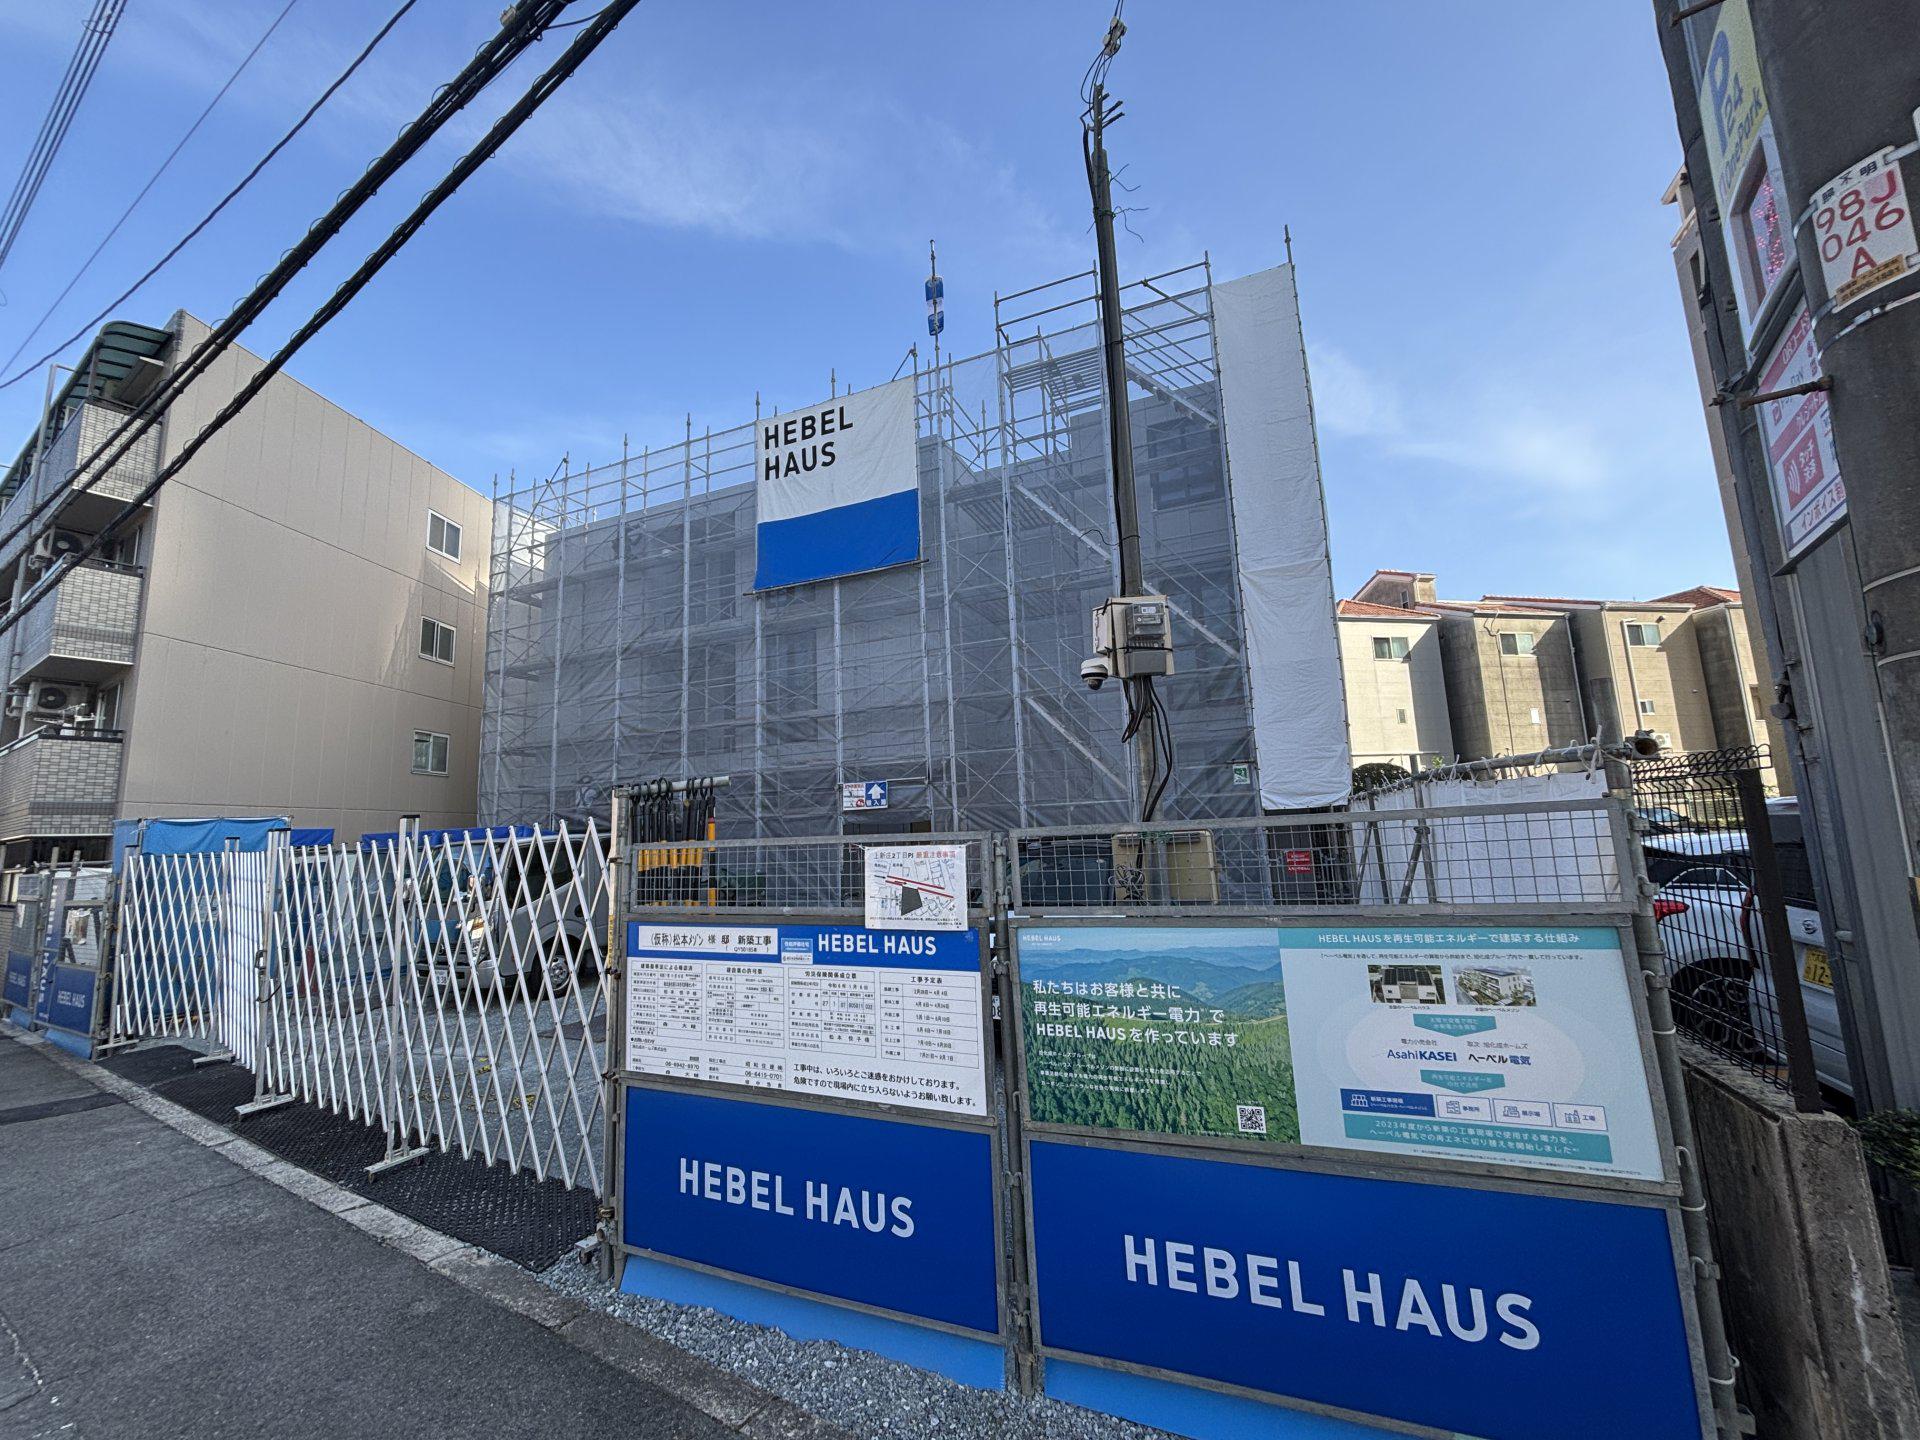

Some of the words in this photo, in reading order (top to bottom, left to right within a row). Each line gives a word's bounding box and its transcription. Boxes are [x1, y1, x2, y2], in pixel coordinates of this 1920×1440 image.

[1724, 72, 1744, 138] 24
[1816, 169, 1897, 234] 98J
[1821, 201, 1906, 263] 046
[1851, 246, 1877, 279] A
[764, 405, 854, 451] HEBEL
[764, 441, 837, 482] HAUS
[737, 934, 772, 947] 新築工事
[818, 933, 879, 954] HEBEL
[884, 935, 937, 956] HAUS
[1318, 934, 1351, 943] HEBEL
[1353, 934, 1382, 943] HAUS
[1383, 933, 1580, 944] を再生可能エネルギーで建築する仕組み
[910, 976, 943, 984] 工事予定表
[1032, 979, 1181, 1000] 私たちはお客様と共に
[1033, 1000, 1200, 1024] 再生可能エネルギー電力
[1036, 1023, 1082, 1039] HEBEL
[1086, 1026, 1126, 1041] HAUS
[1129, 1028, 1239, 1048] を作っています
[1387, 1048, 1458, 1063] AsahiKASEI
[793, 1063, 960, 1091] 工事中は、いろいろとご迷惑をおかけしております。
[793, 1076, 977, 1107] 危険ですので現場内に立ち入らないようお願い致します。
[1582, 1114, 1596, 1122] 工場
[680, 1157, 795, 1216] HEBEL
[806, 1180, 915, 1239] HAUS
[1124, 1234, 1326, 1318] HEBEL
[1343, 1268, 1541, 1351] HAUS
